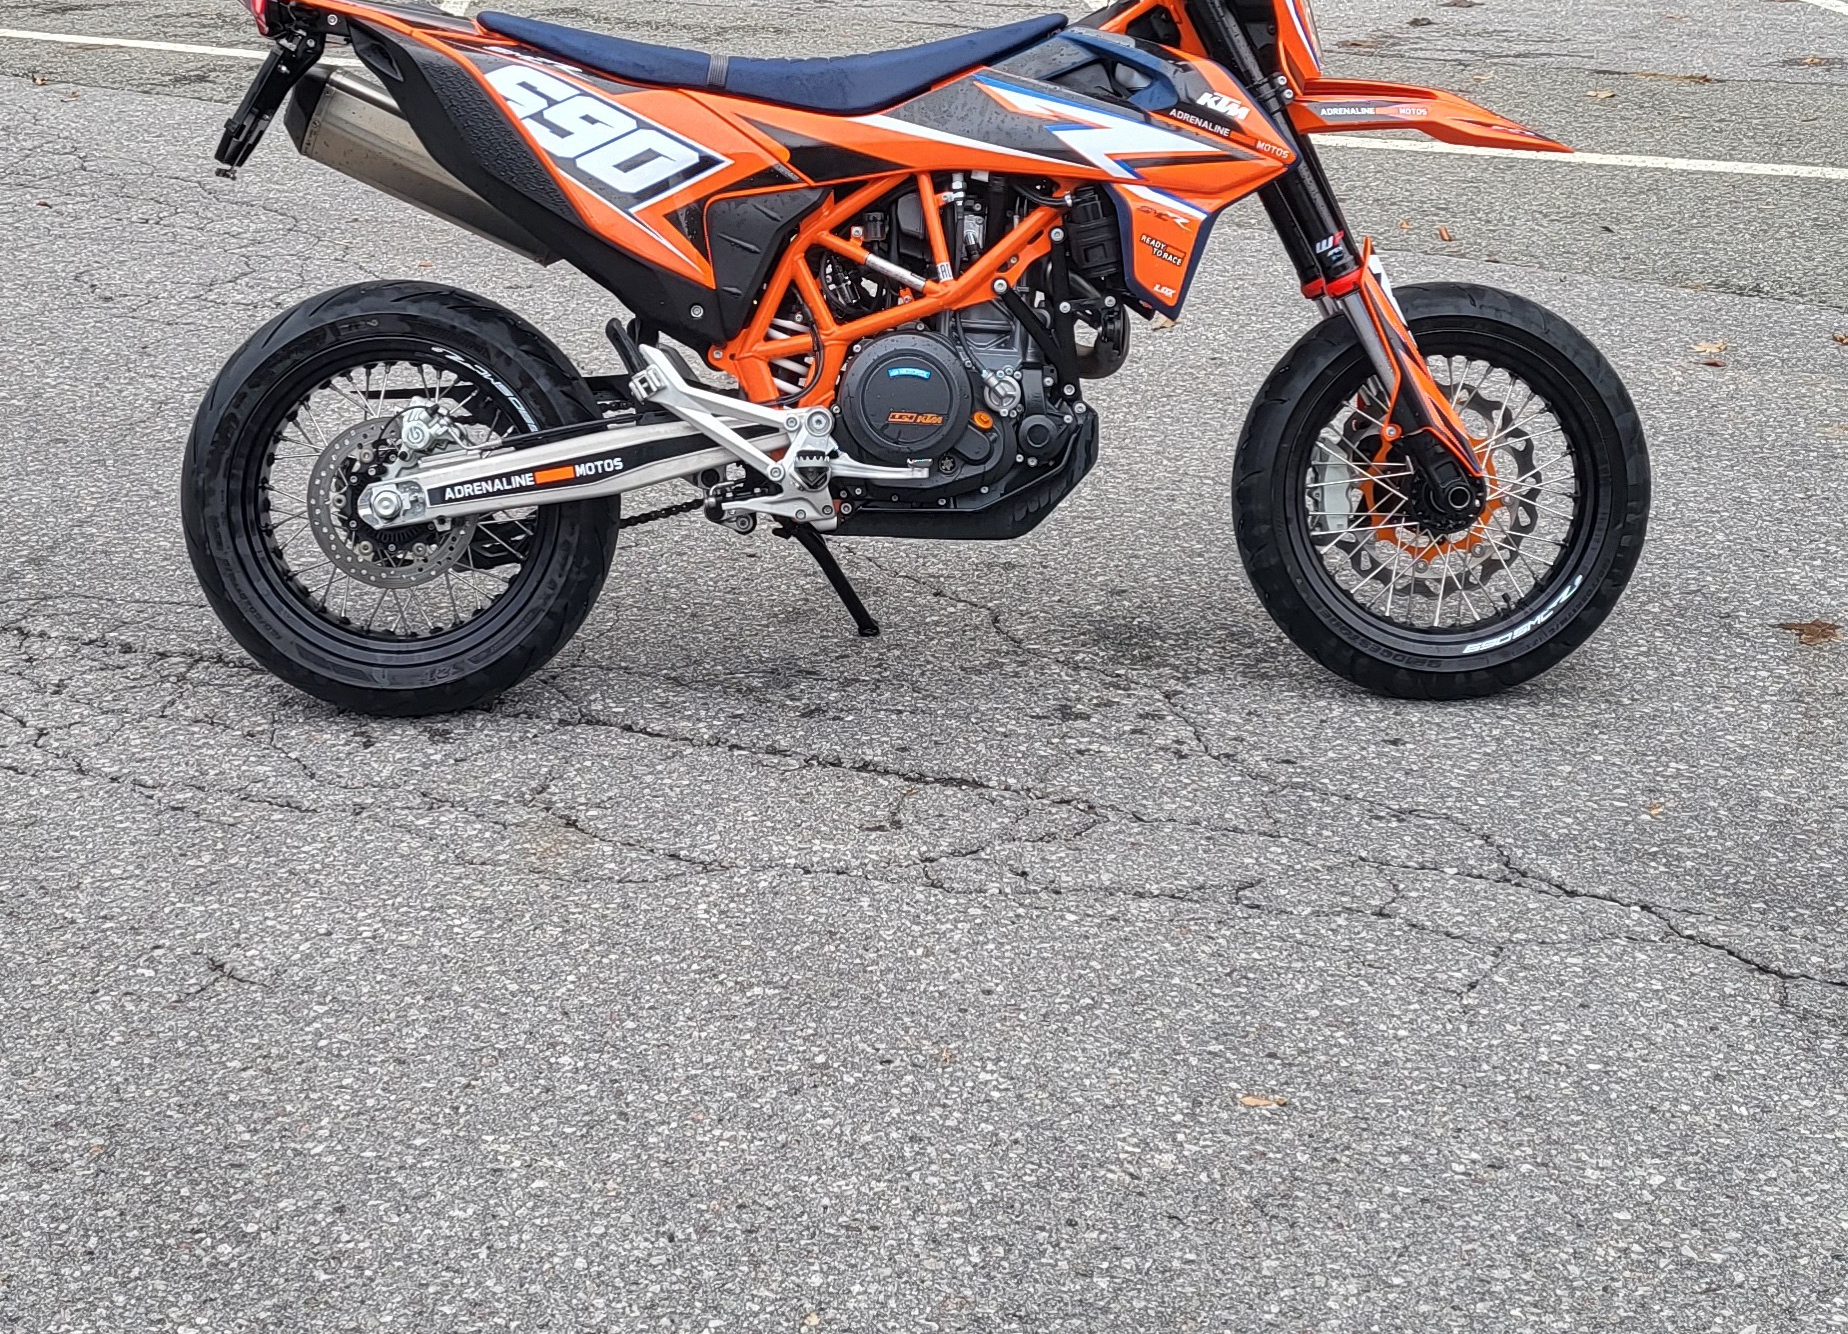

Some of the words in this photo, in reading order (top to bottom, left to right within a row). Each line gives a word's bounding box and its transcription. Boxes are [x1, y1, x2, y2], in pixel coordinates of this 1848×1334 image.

[1196, 91, 1251, 120] KTM
[1320, 106, 1376, 116] ADRENALINE
[1399, 107, 1428, 116] MOTOS
[1169, 108, 1231, 137] ADRENALINE
[1256, 140, 1290, 159] MOTOS
[1141, 234, 1167, 250] READY
[1315, 230, 1345, 254] WP
[1153, 247, 1163, 257] TO
[1162, 251, 1183, 266] RACE
[916, 413, 943, 424] KTM
[445, 473, 535, 501] ADRENALINE
[575, 458, 623, 478] MOTOS
